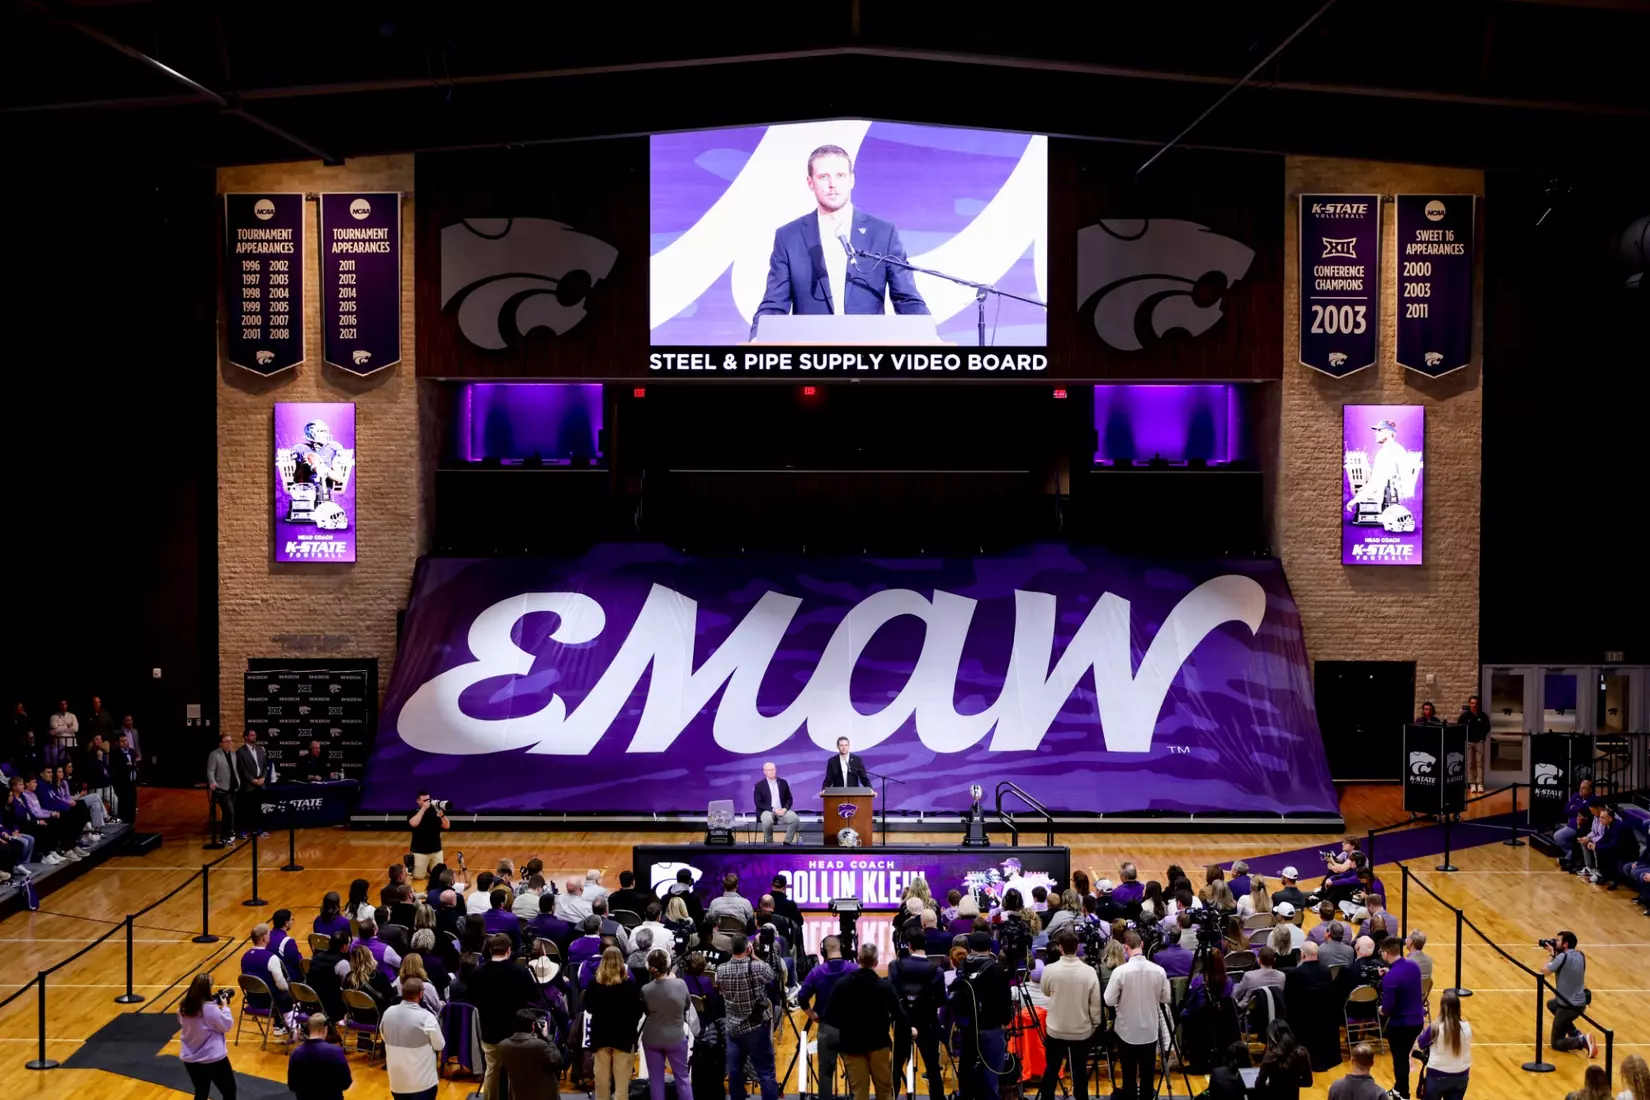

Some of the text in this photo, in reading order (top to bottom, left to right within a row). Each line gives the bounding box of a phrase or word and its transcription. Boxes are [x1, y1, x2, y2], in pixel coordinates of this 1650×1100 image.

[1312, 204, 1368, 214] K-STATE
[237, 229, 292, 240] TOURNAMENT
[333, 228, 388, 239] TOURNAMENT
[1416, 230, 1454, 241] SWEET 16
[236, 242, 294, 253] APPEARANCES
[332, 242, 390, 253] APPEARANCES
[1406, 244, 1464, 255] APPEARANCES
[242, 260, 289, 271] 1996 2002
[339, 260, 355, 271] 2011
[1403, 262, 1431, 276] 2000
[1314, 266, 1364, 277] CONFERENCE
[242, 274, 289, 285] 1997 2003
[339, 274, 356, 284] 2012
[1315, 279, 1363, 291] CHAMPIONS
[1404, 283, 1431, 297] 2003
[242, 288, 289, 298] 1998 2004
[339, 288, 356, 298] 2014
[242, 301, 289, 312] 1999 2005
[339, 301, 356, 312] 2015
[1406, 304, 1428, 318] 2011
[241, 315, 289, 326] 2000 2007
[339, 315, 357, 325] 2016
[1311, 305, 1367, 334] 2003
[242, 329, 289, 339] 2001 2008
[339, 328, 357, 339] 2021
[650, 354, 1048, 370] STEEL & PIPE SUPPLY VIDEO BOARD
[285, 542, 347, 552] K-STATE
[1352, 544, 1414, 555] K-STATE
[1410, 775, 1436, 784] K-STATE
[809, 861, 894, 869] HEAD COACH
